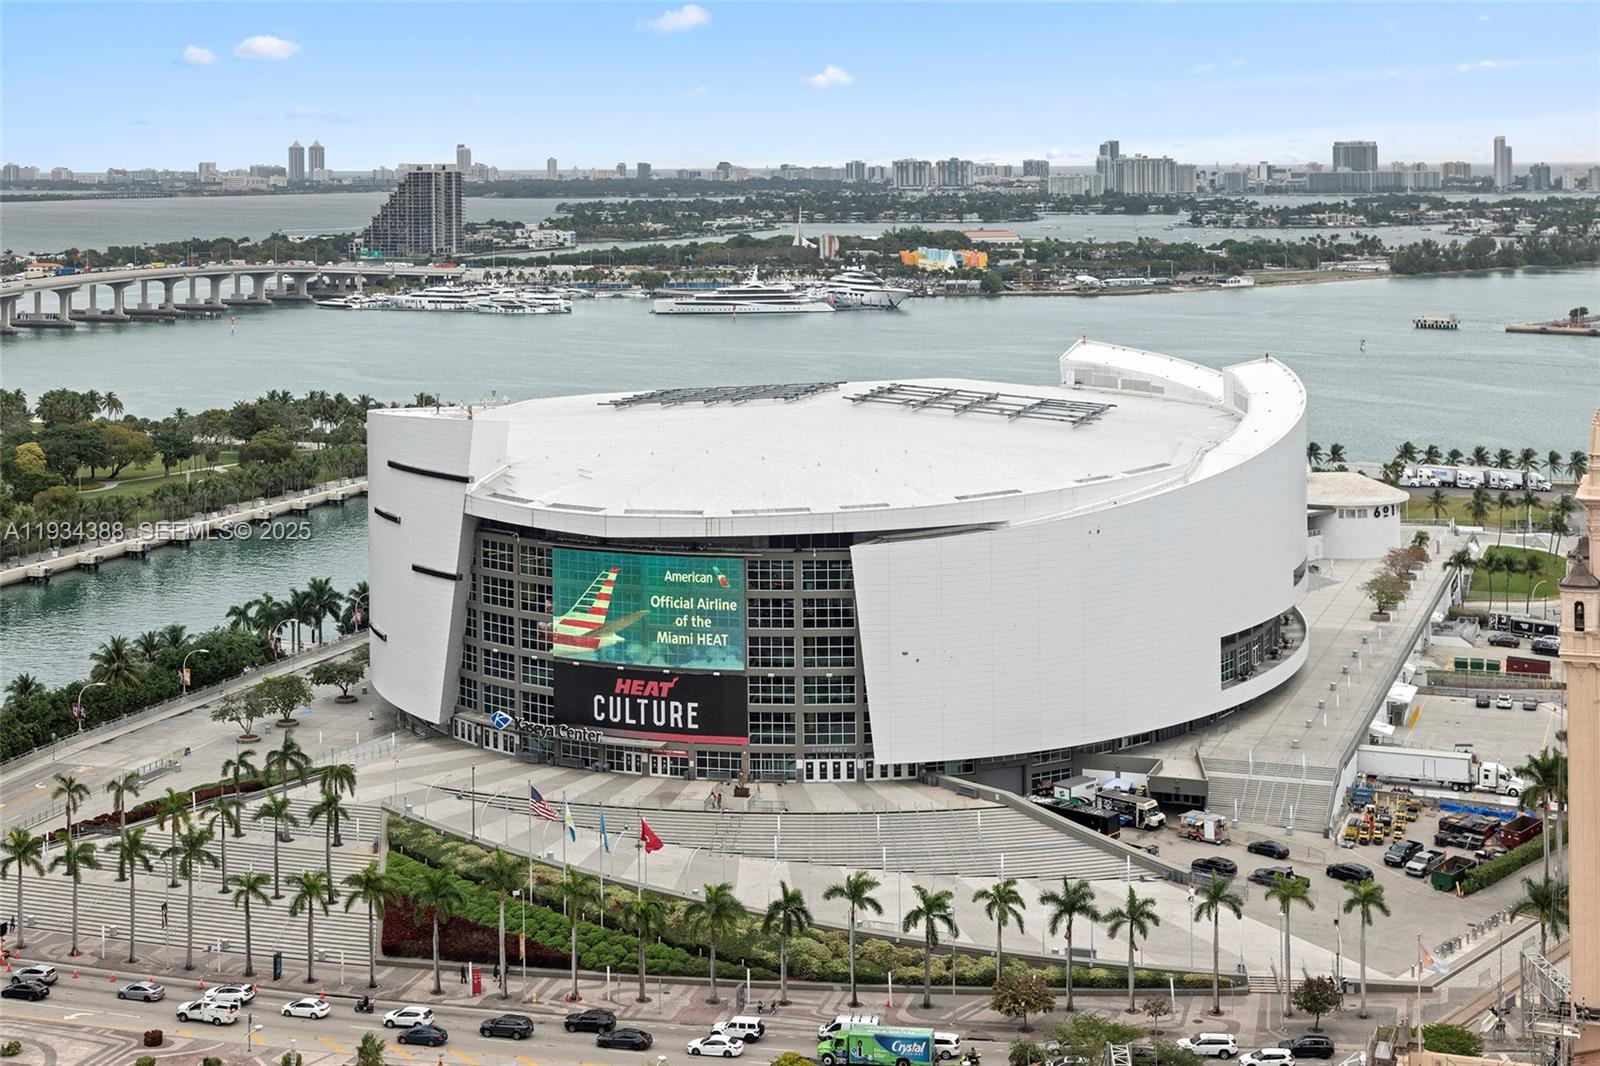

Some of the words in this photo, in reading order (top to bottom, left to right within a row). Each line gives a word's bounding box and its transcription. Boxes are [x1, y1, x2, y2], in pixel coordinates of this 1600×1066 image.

[664, 570, 713, 583] American
[650, 595, 693, 610] Official
[697, 598, 737, 611] Airline
[675, 615, 688, 627] of
[691, 616, 712, 628] the
[657, 631, 693, 645] Miami
[697, 633, 729, 646] HEAT
[614, 676, 680, 698] HEAT
[593, 694, 699, 729] CULTURE
[514, 716, 556, 739] Kaseya
[558, 724, 604, 742] Center
[891, 1040, 927, 1056] Crystal
